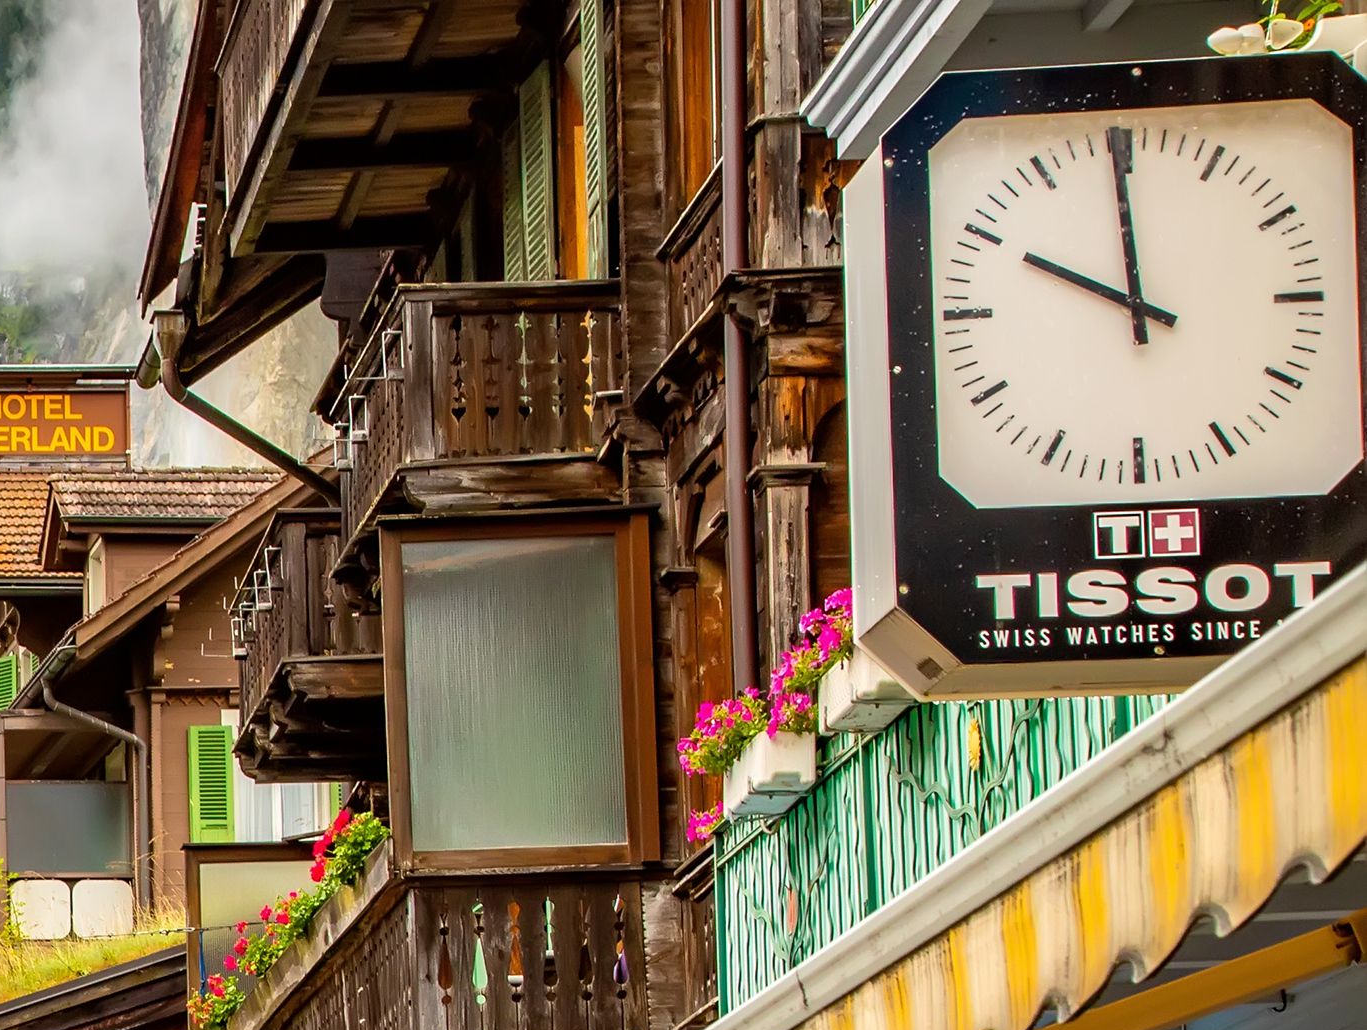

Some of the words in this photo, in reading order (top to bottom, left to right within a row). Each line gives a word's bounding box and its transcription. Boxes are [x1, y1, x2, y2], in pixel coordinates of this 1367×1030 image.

[975, 561, 1331, 620] TISSOT
[978, 627, 1052, 649] SWISS
[1067, 623, 1175, 646] WATCHES
[1191, 620, 1261, 642] SINCE
